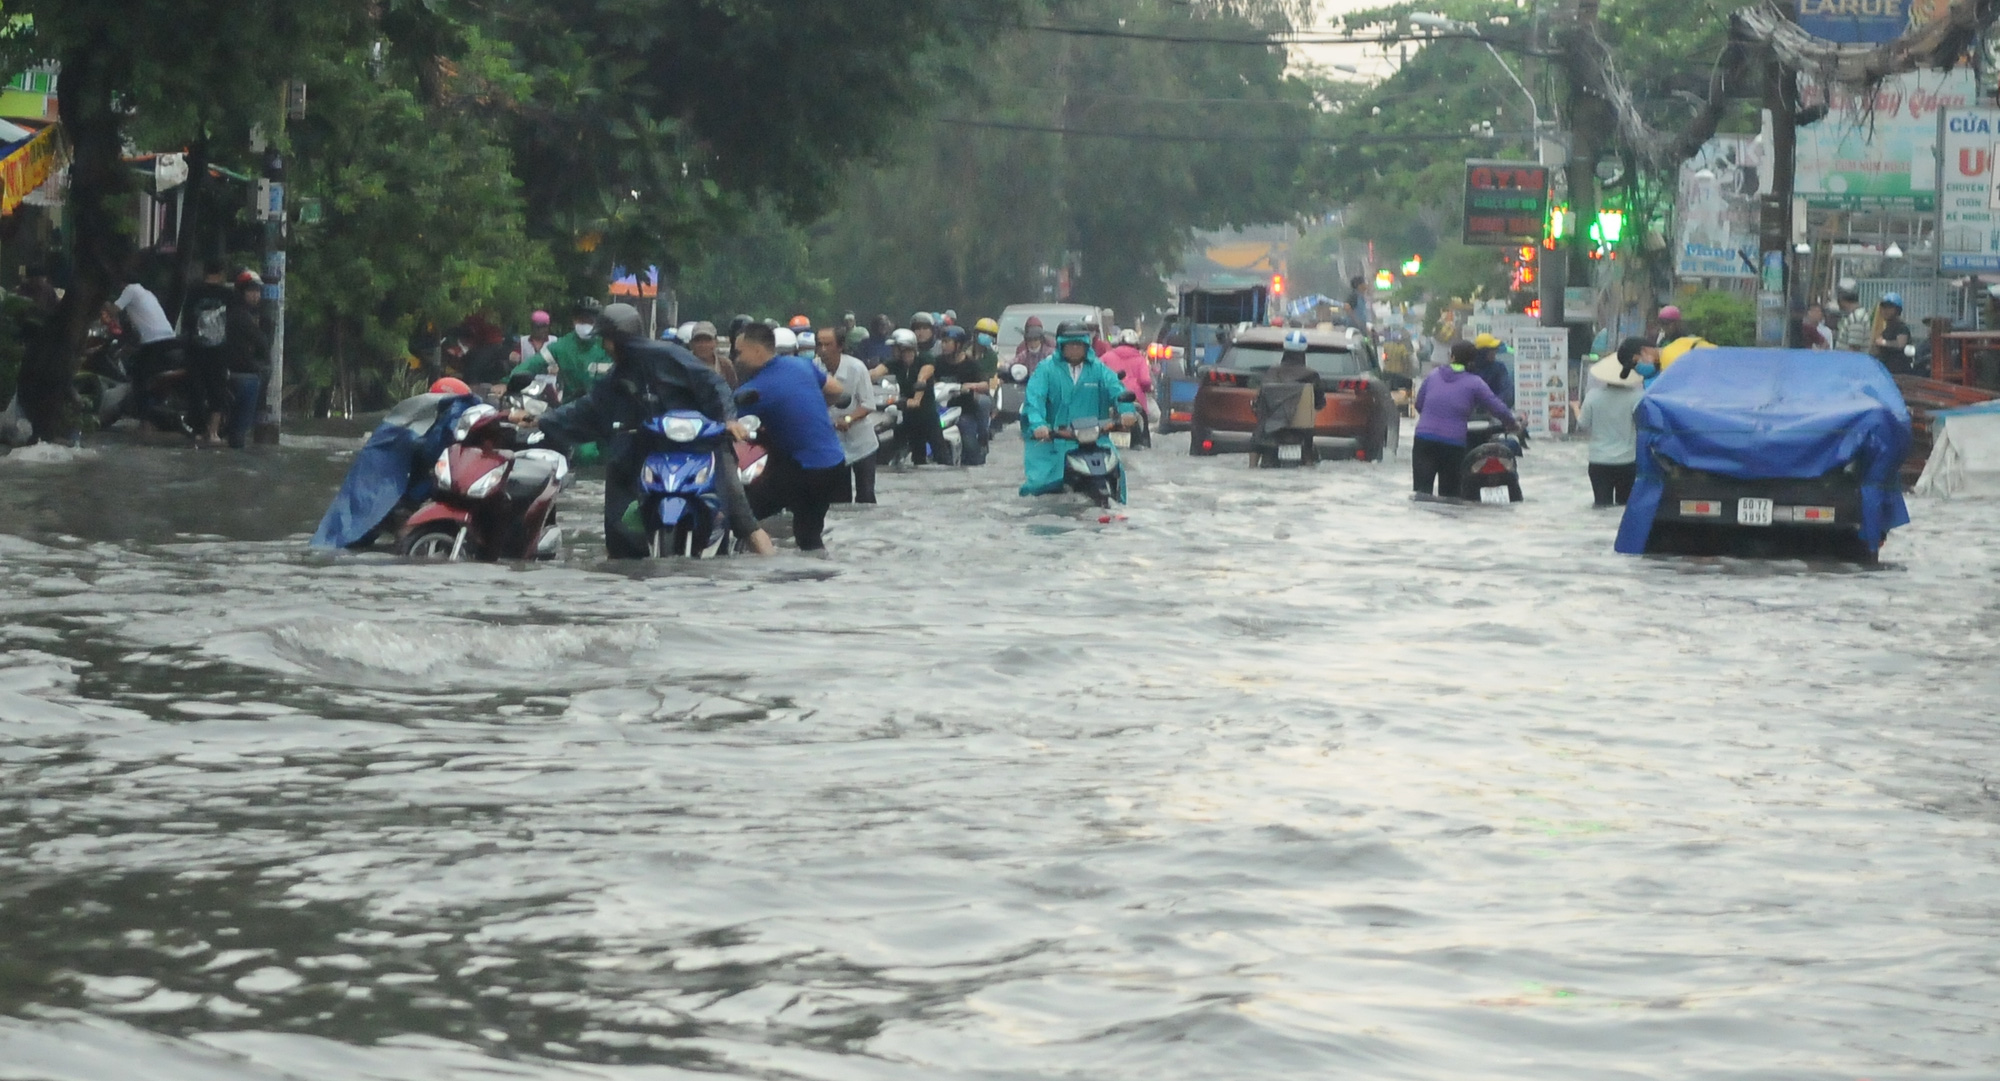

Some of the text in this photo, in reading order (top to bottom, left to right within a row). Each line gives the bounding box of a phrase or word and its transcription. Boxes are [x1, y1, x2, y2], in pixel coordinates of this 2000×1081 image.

[1801, 0, 1899, 15] LARUE
[1950, 111, 1990, 133] CỬA
[1471, 167, 1543, 189] GYM
